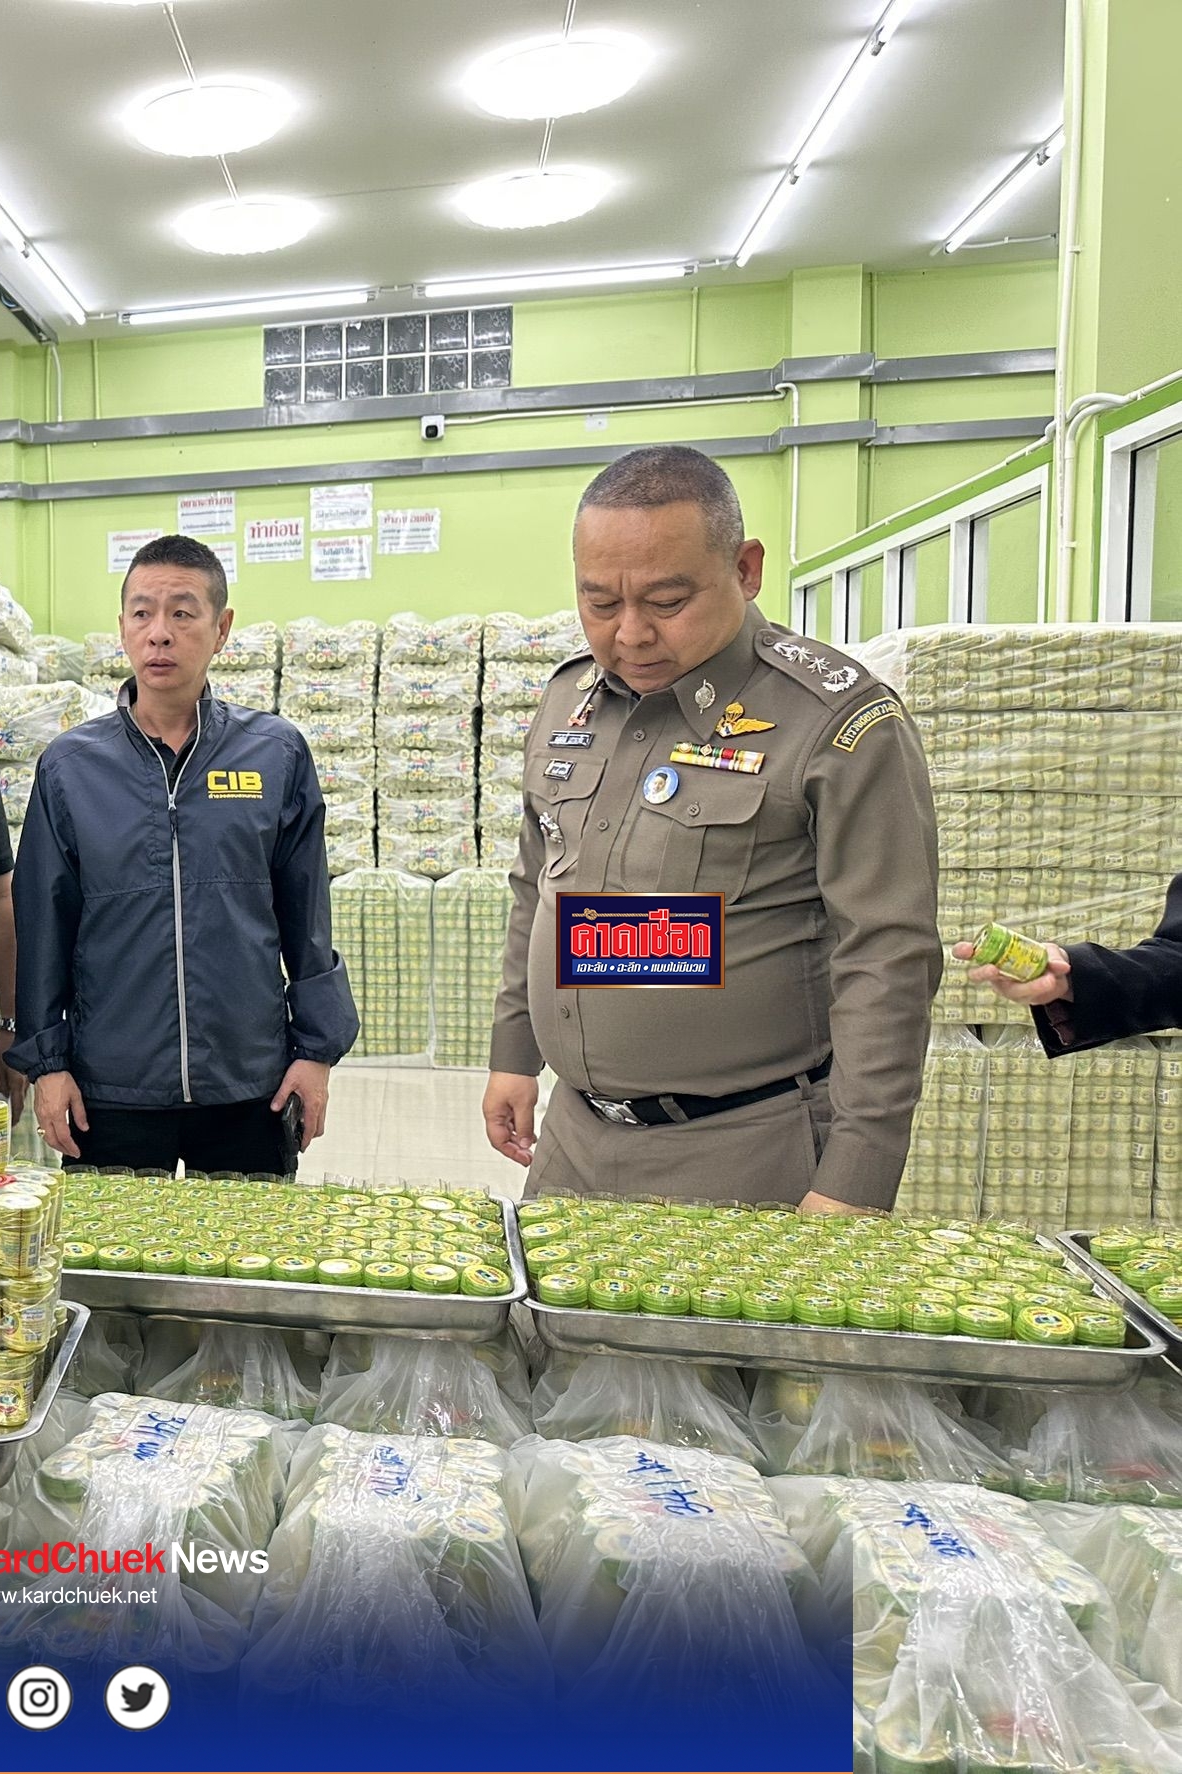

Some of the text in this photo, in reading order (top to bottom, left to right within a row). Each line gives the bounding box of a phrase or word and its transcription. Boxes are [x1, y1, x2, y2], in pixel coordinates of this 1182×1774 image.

[250, 520, 300, 539] ทำก่อน
[207, 770, 263, 791] CIB
